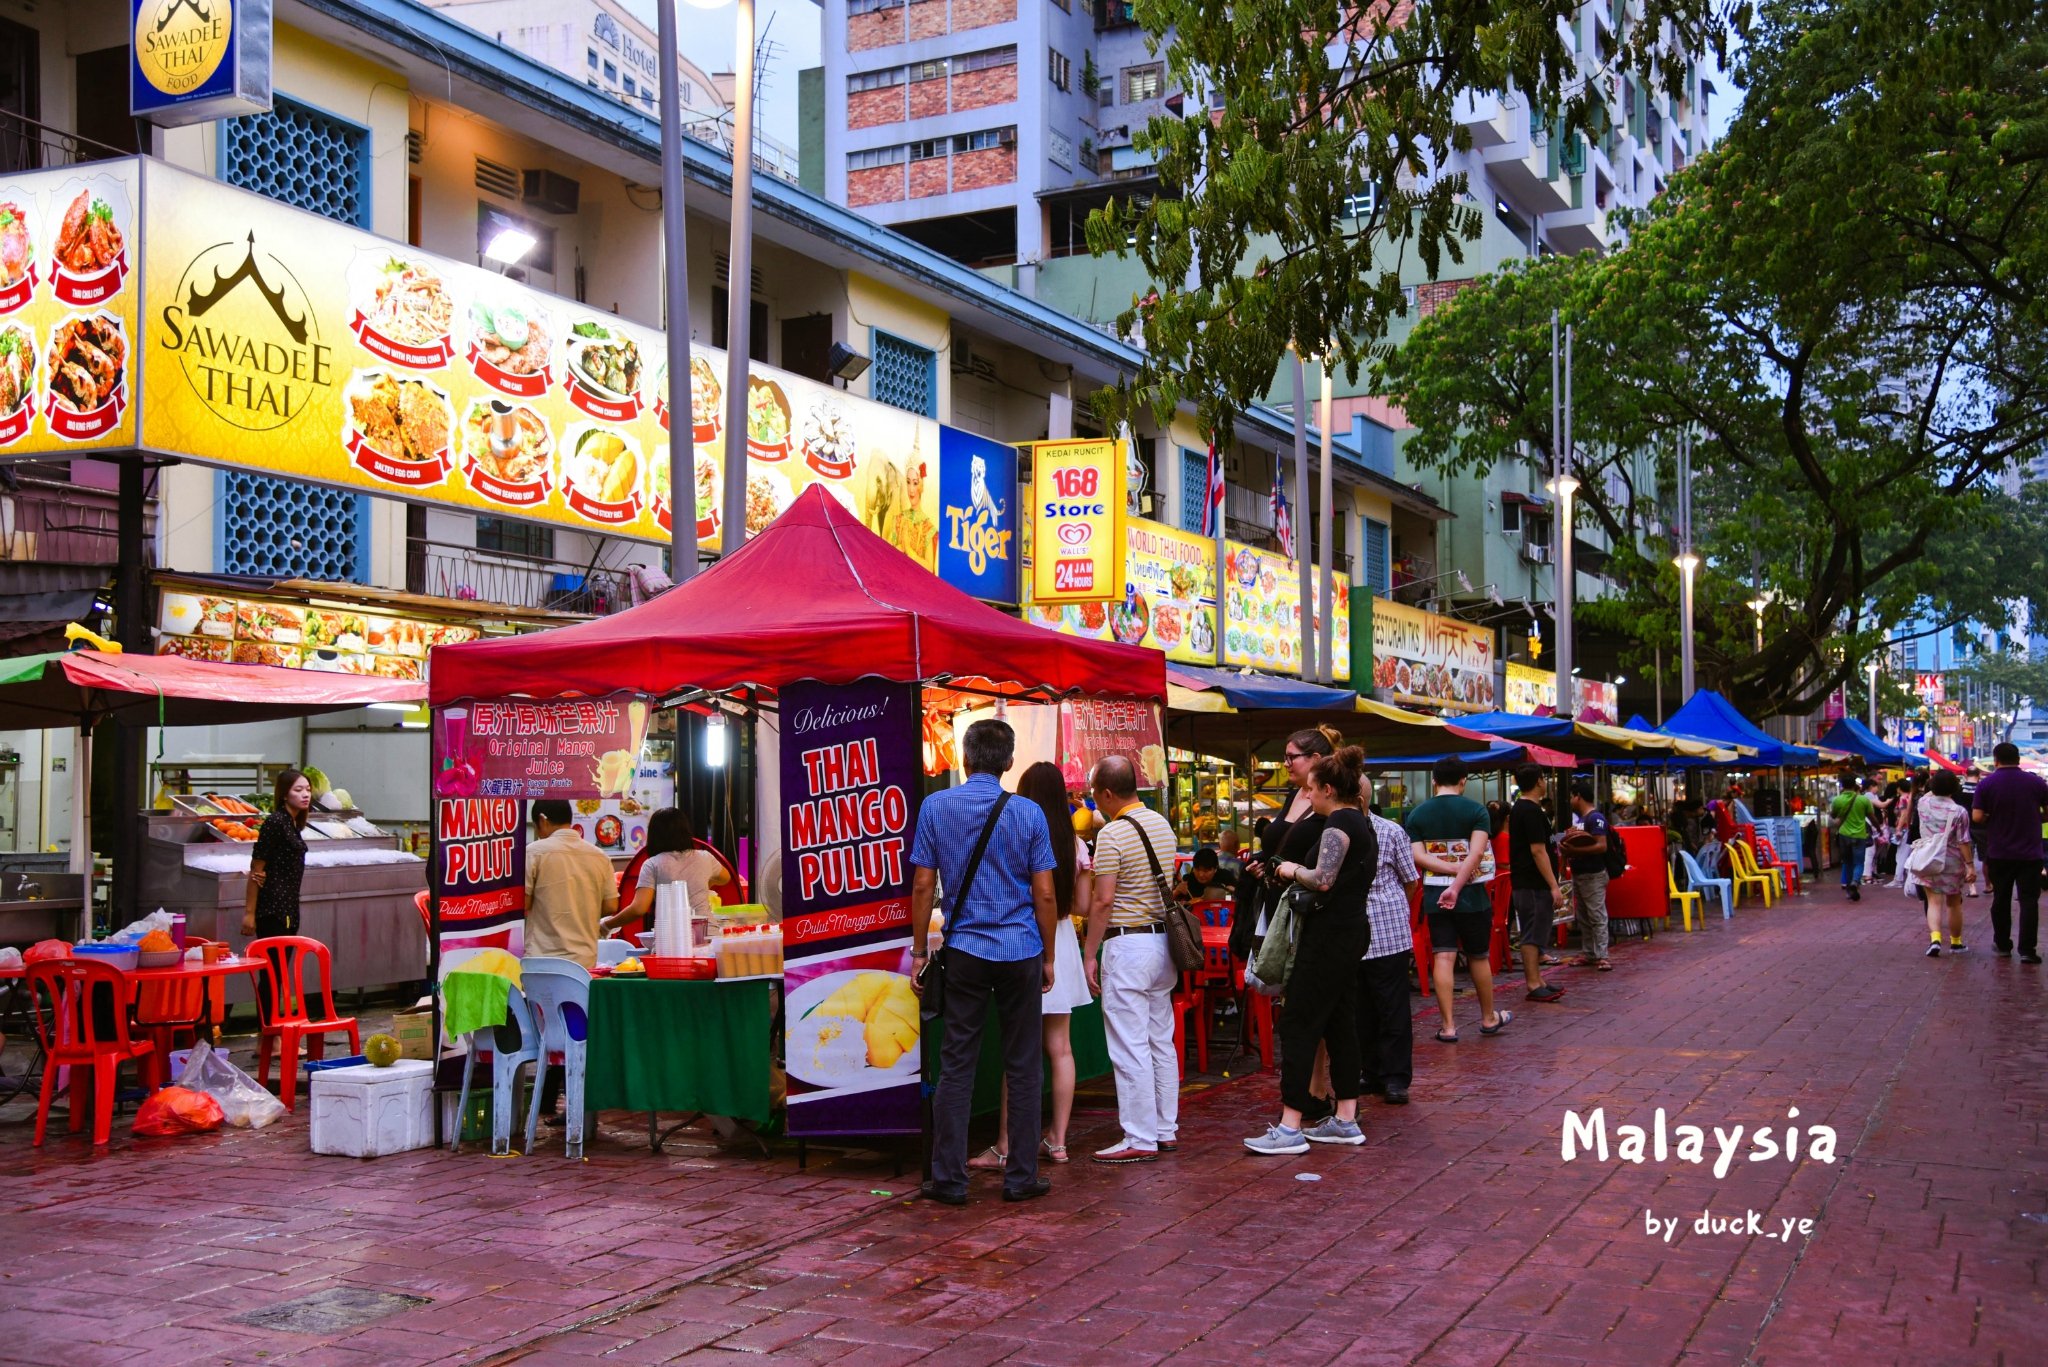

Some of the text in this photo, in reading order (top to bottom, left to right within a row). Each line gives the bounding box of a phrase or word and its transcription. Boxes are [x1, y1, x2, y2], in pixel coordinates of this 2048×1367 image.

[145, 18, 223, 54] SAWADEE
[161, 46, 204, 70] THAI
[622, 33, 657, 79] Hotel
[166, 73, 198, 90] FOOD
[161, 305, 332, 387] SAWADEE
[391, 348, 406, 362] WITH
[406, 352, 428, 365] FLOWER
[197, 364, 291, 418] THAI
[511, 380, 523, 393] CAKE
[1046, 446, 1104, 458] KEDAI RUNCIT
[374, 460, 421, 479] SALTED EGG CRAB
[1051, 466, 1100, 500] 168
[502, 490, 522, 501] SEAFOOD
[522, 490, 535, 500] SOUP
[1044, 502, 1105, 518] Store
[946, 504, 1012, 576] Tiger
[1127, 526, 1202, 567] WORLD THAI FOOD
[1055, 562, 1093, 589] 24 JAM
[1073, 576, 1093, 589] HOURS
[1407, 620, 1420, 653] TKS
[1421, 614, 1469, 673] 川行天下
[1918, 674, 1938, 688] KK
[472, 700, 619, 736] 原汁原味芒果汁
[793, 696, 890, 735] Delicious!
[1072, 700, 1148, 731] 原汁原味芒果汁
[488, 737, 596, 758] Original Mango
[526, 758, 565, 776] Juice
[639, 763, 658, 778] sine
[801, 737, 880, 797] THAI
[480, 778, 523, 796] 火龍果汁
[526, 778, 573, 788] Dragon Fruits
[526, 788, 545, 797] Juice
[439, 797, 520, 842] MANGO
[788, 784, 908, 852] MANGO
[445, 837, 515, 886] PULUT
[798, 836, 905, 901] PULUT
[439, 899, 466, 916] Pulut
[796, 902, 907, 939] Pulut Mangga Thai
